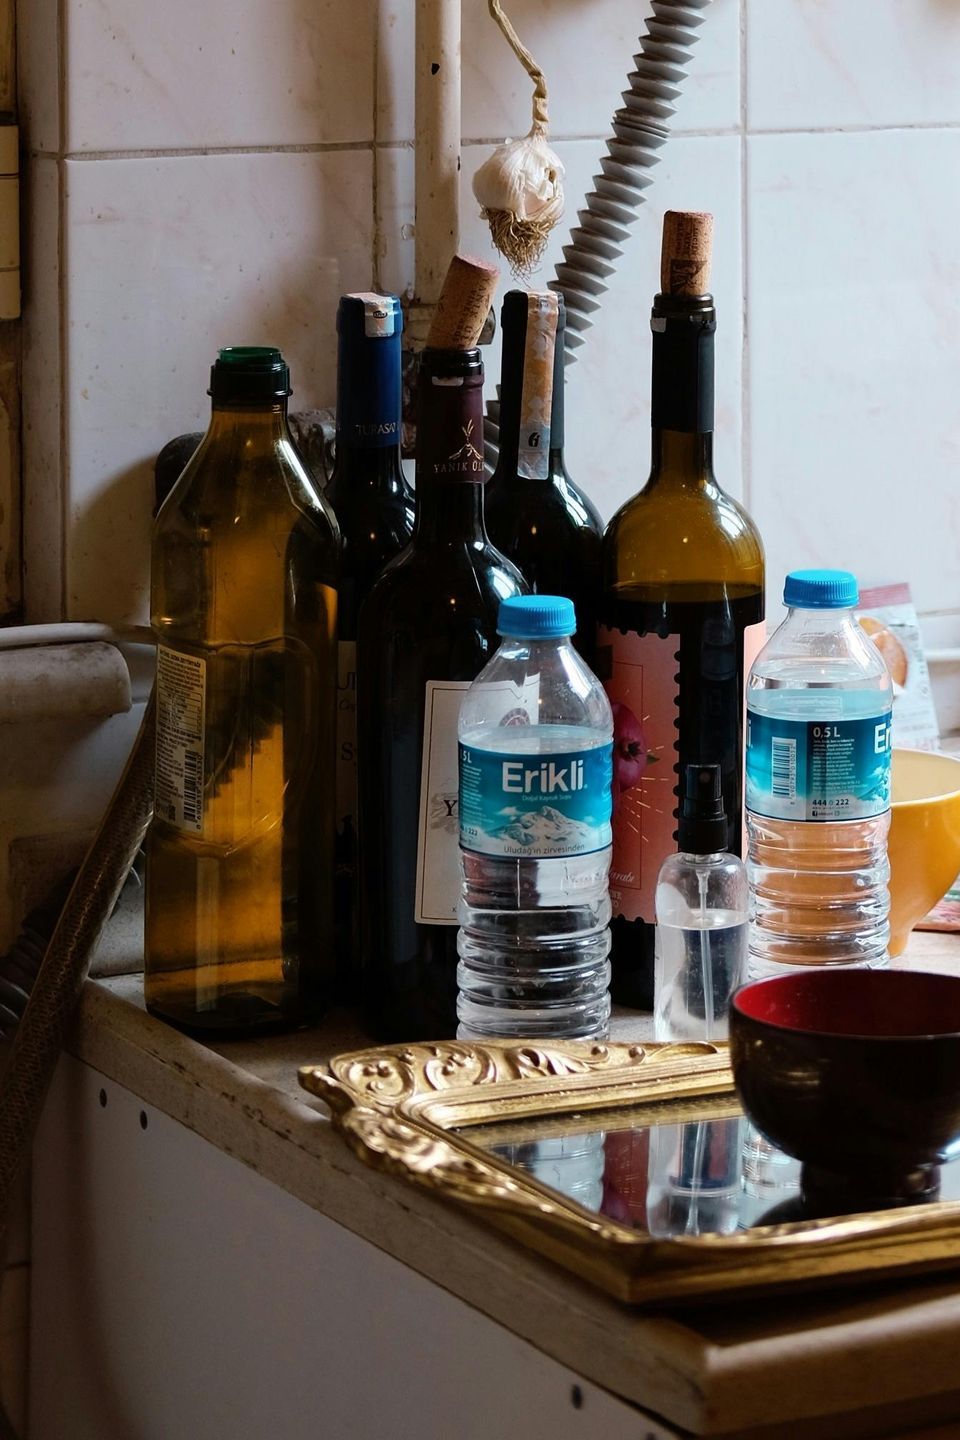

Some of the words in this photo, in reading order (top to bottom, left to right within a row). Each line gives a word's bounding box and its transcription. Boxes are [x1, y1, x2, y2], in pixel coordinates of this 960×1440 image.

[833, 726, 841, 738] L
[502, 759, 584, 794] Erikli
[812, 799, 827, 807] 444
[836, 798, 850, 806] 222
